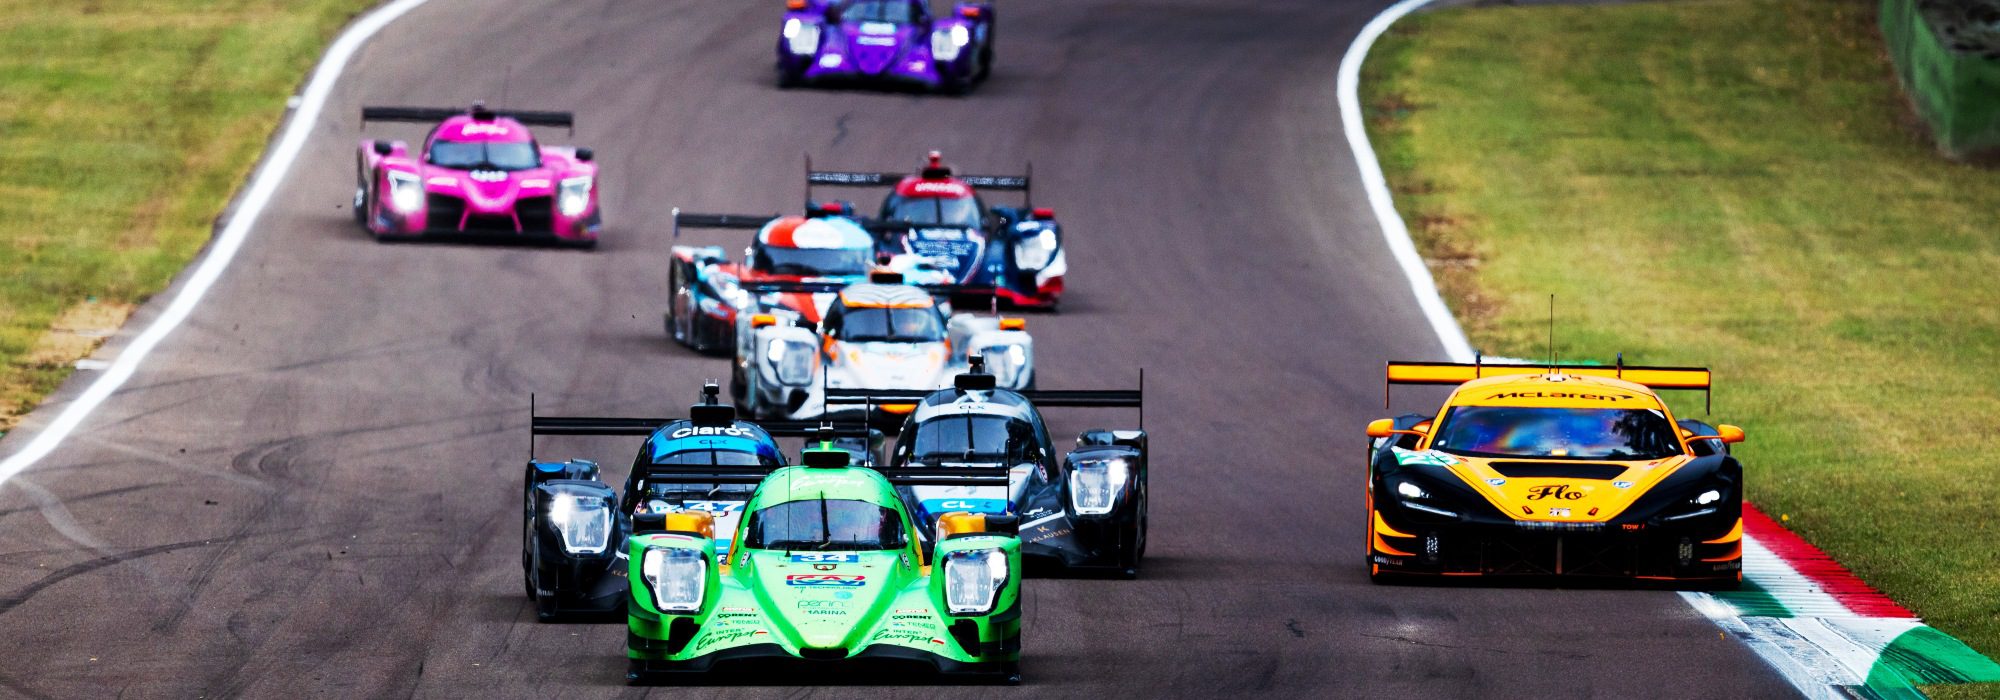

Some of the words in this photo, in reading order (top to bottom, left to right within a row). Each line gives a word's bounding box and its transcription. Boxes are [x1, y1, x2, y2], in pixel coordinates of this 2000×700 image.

[1484, 392, 1618, 402] McLaren
[672, 424, 742, 438] Claro
[1527, 485, 1586, 500] Flo
[688, 501, 745, 511] 47
[800, 553, 856, 562] 34
